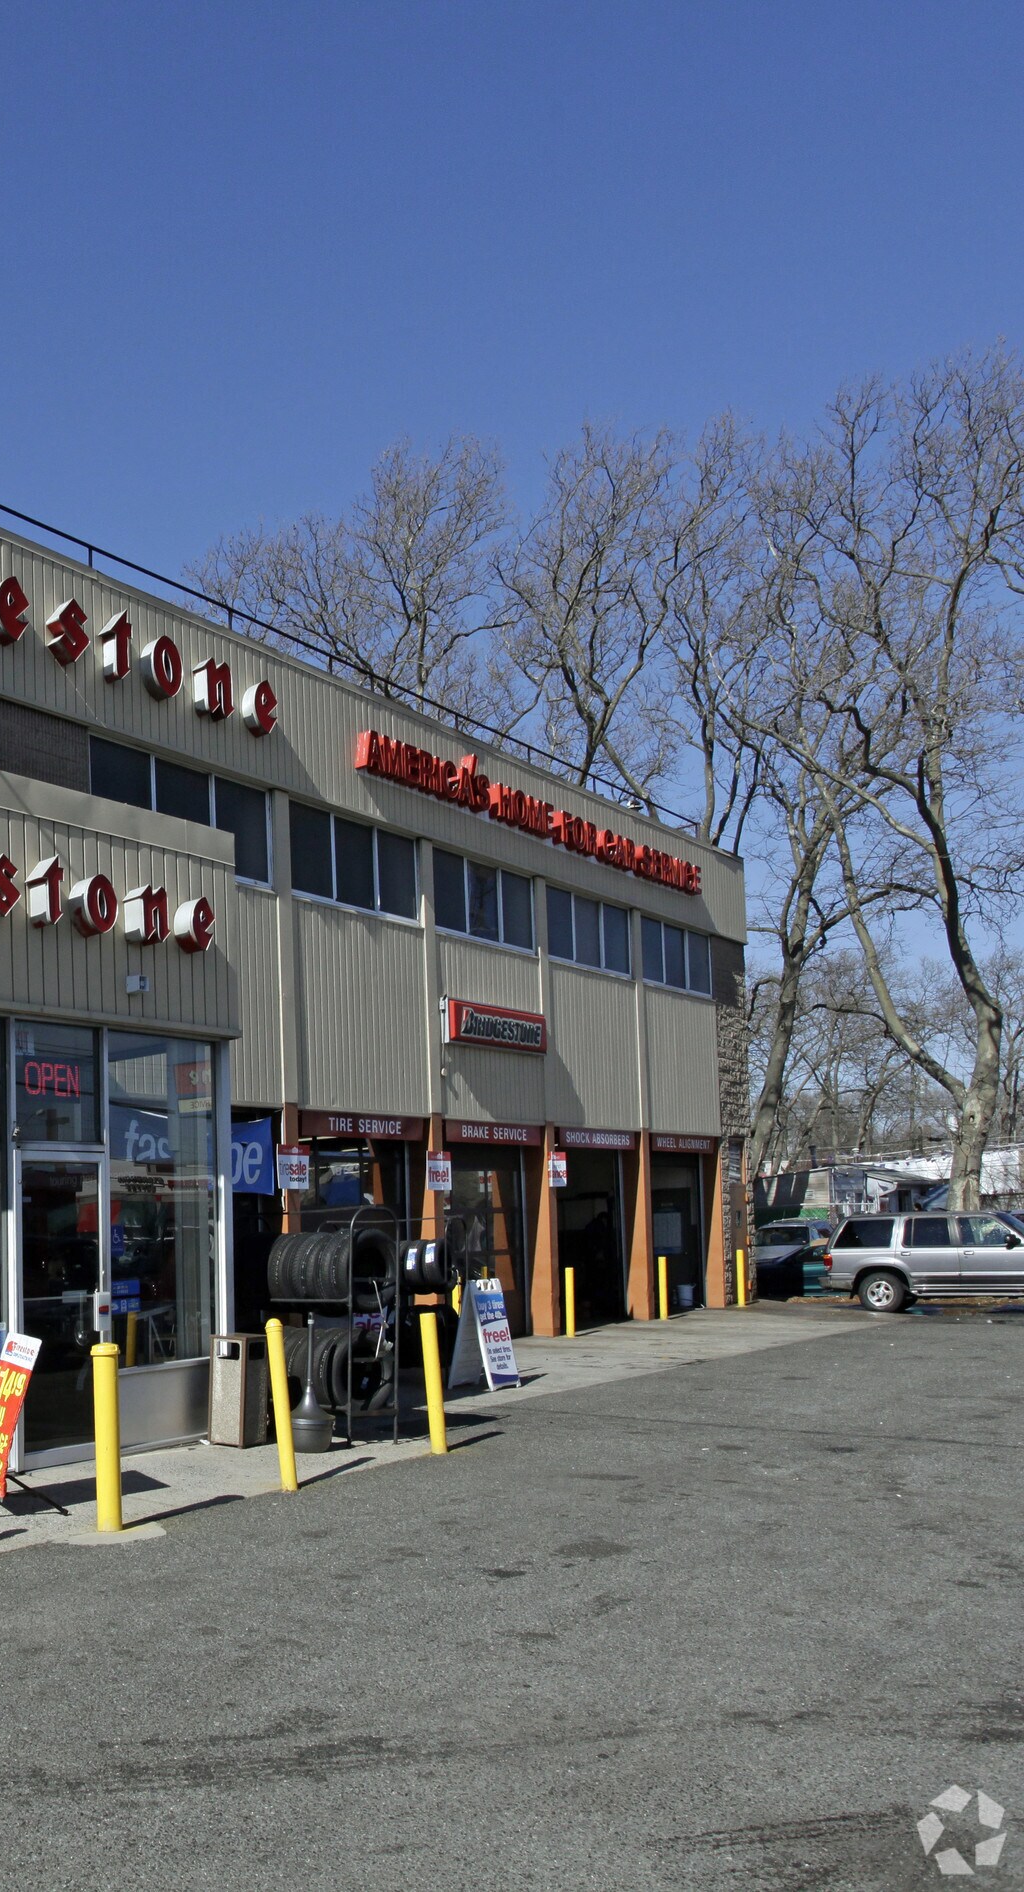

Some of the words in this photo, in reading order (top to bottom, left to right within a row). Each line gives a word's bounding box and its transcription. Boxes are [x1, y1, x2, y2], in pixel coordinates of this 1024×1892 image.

[355, 729, 491, 813] AMERICA'S
[491, 782, 554, 840] HOME
[553, 810, 598, 857] FOR
[596, 829, 637, 872] CAR
[634, 844, 702, 896] SERVICE
[461, 1006, 542, 1046] BRIDGESTONE
[25, 1061, 80, 1098] OPEN
[329, 1116, 353, 1132] TIRE
[358, 1119, 402, 1135] SERVICE
[461, 1125, 489, 1139] BRAKE
[493, 1127, 527, 1141] SERVICE
[565, 1131, 590, 1144] SHOCK
[592, 1133, 630, 1146] ABSORBERS
[657, 1137, 677, 1148] WHEEL
[678, 1138, 711, 1149] ALIGNMENT
[429, 1166, 449, 1183] free!
[483, 1327, 511, 1344] free!
